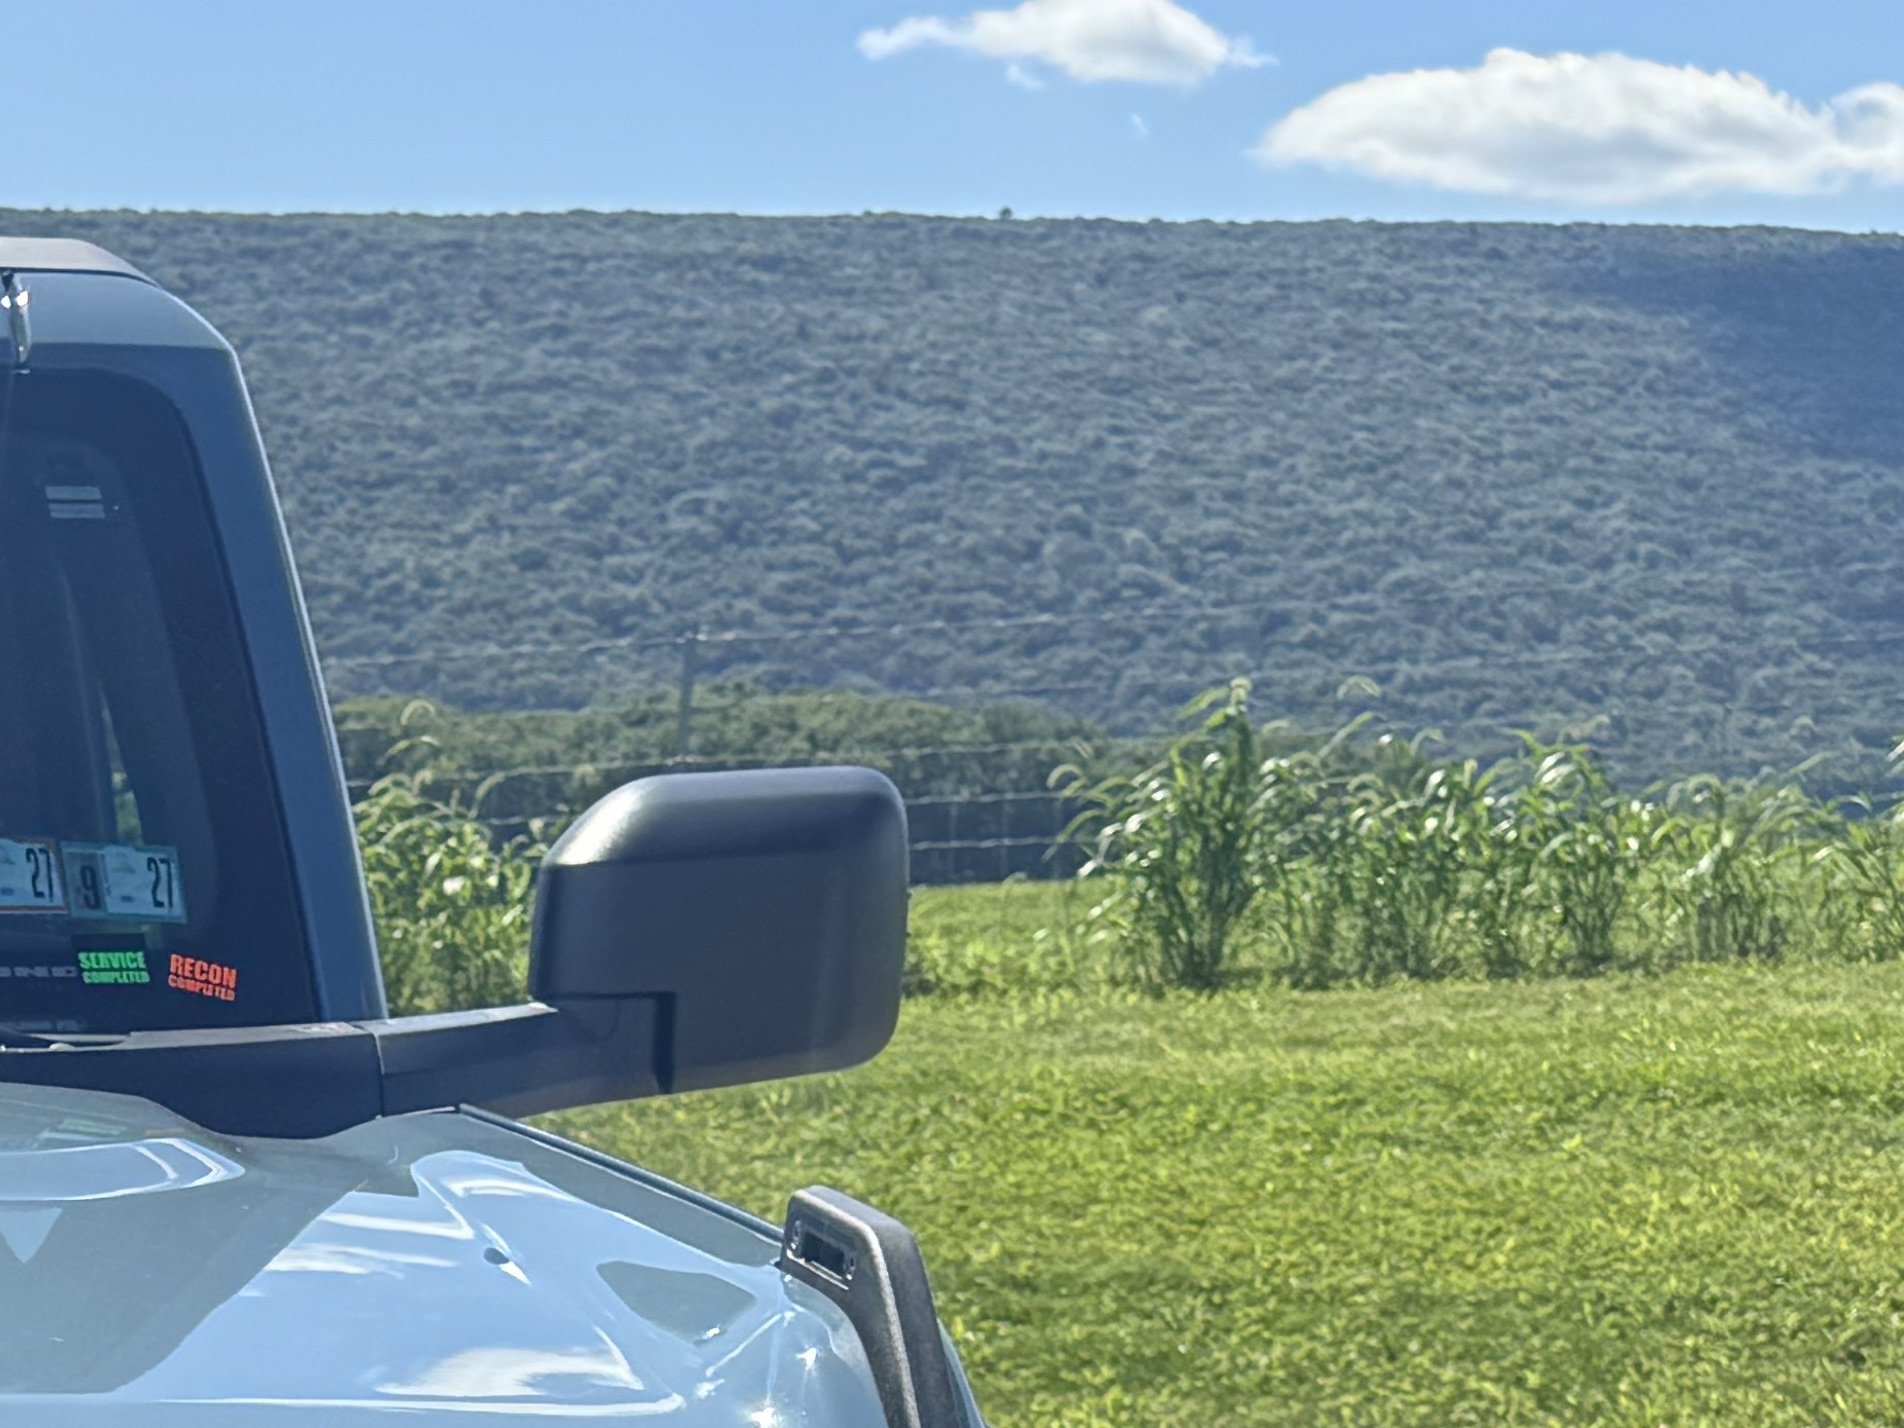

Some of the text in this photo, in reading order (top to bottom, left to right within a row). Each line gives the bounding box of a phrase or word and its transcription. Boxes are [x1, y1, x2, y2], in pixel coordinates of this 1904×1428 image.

[25, 846, 54, 903] 27
[79, 856, 175, 910] 9 27
[78, 951, 147, 969] SERVICE
[170, 953, 237, 988] RECON
[82, 971, 151, 984] COMPLETED
[168, 974, 236, 1001] COMPLETED
